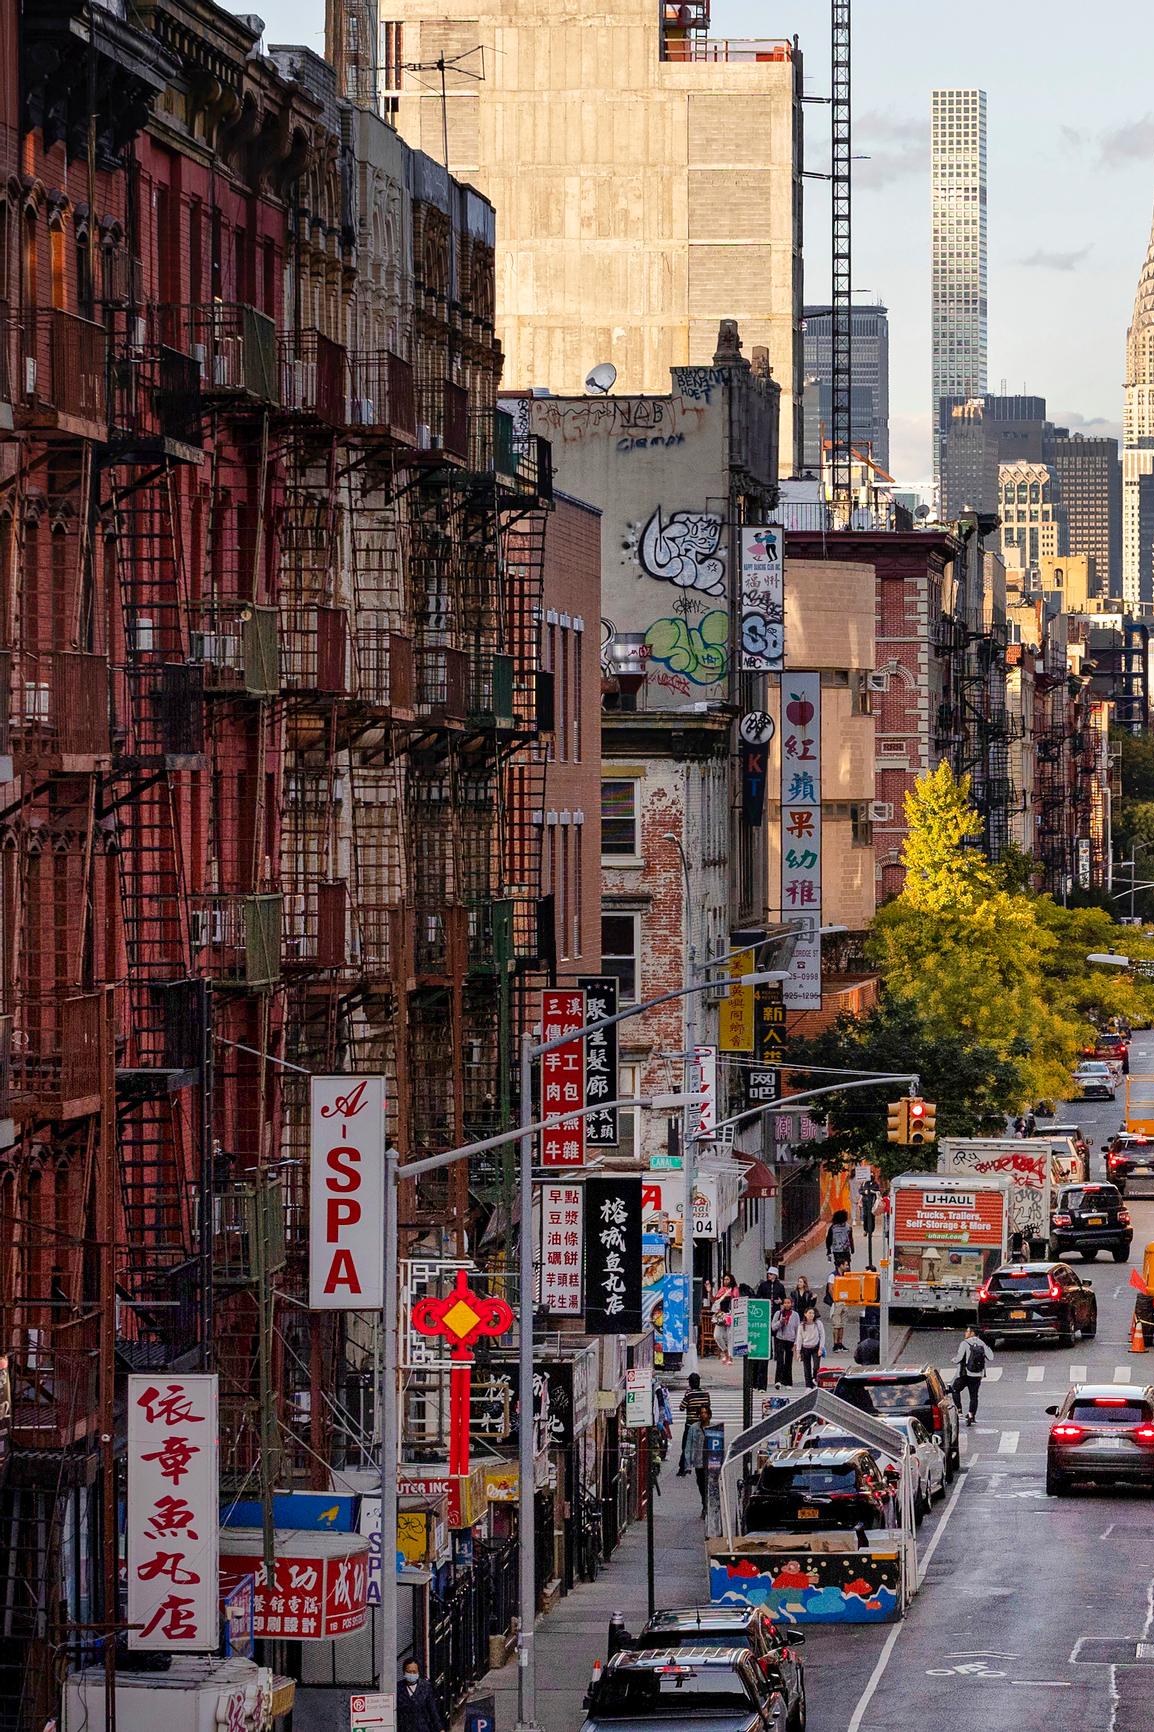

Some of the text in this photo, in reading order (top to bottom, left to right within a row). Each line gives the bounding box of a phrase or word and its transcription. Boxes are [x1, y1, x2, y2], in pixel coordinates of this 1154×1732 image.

[545, 1053, 579, 1072] 手工
[546, 1082, 579, 1101] 肉包
[749, 1073, 776, 1099] 网吧
[545, 1141, 579, 1160] 牛雜
[651, 1157, 672, 1167] CANAL
[549, 1190, 579, 1204] 早點
[926, 1195, 973, 1205] U-HAUL
[549, 1211, 578, 1225] 豆漿
[917, 1211, 982, 1221] Trucks, Trailers,
[906, 1220, 992, 1230] Self-Storage & More
[548, 1232, 578, 1246] 油條
[546, 1273, 579, 1287] 芋頭糕
[429, 1481, 453, 1494] INC.
[137, 1385, 205, 1640] 依章魚丸店
